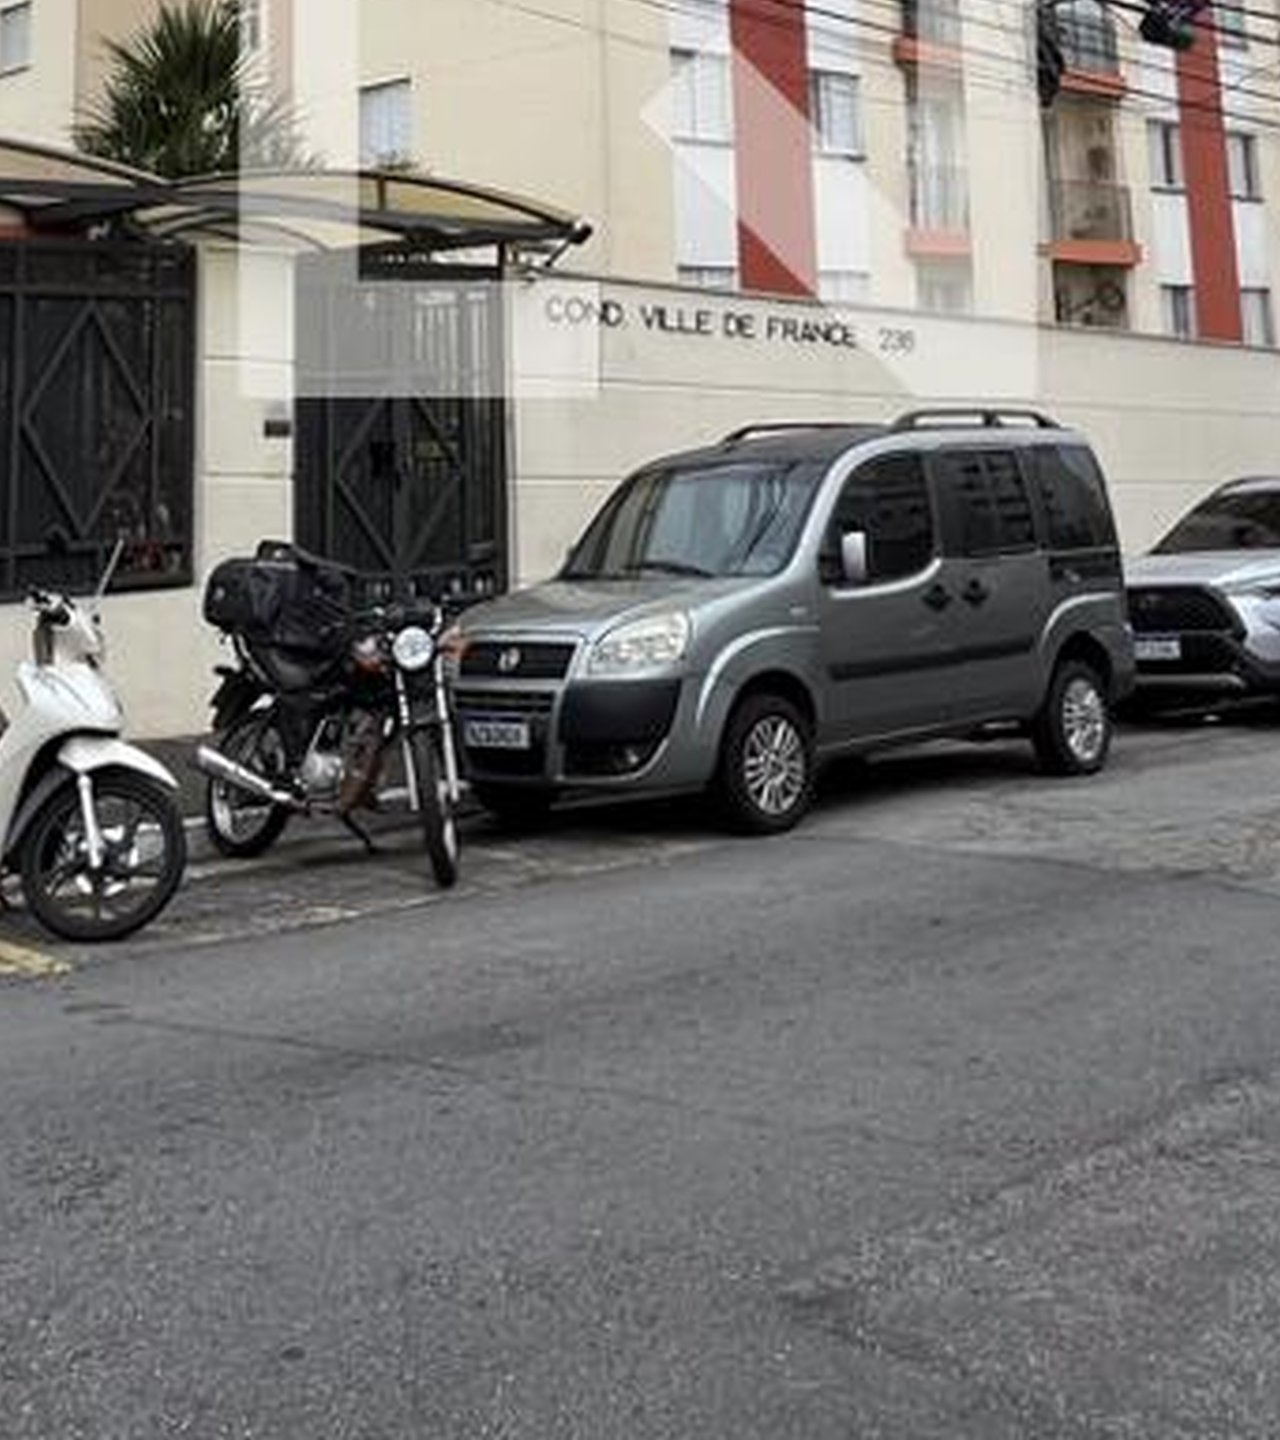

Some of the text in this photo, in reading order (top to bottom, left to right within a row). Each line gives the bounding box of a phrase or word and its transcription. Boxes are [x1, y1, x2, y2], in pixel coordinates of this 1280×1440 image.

[639, 306, 711, 336] VILLE
[724, 312, 755, 339] DE
[767, 317, 857, 349] FRANCE
